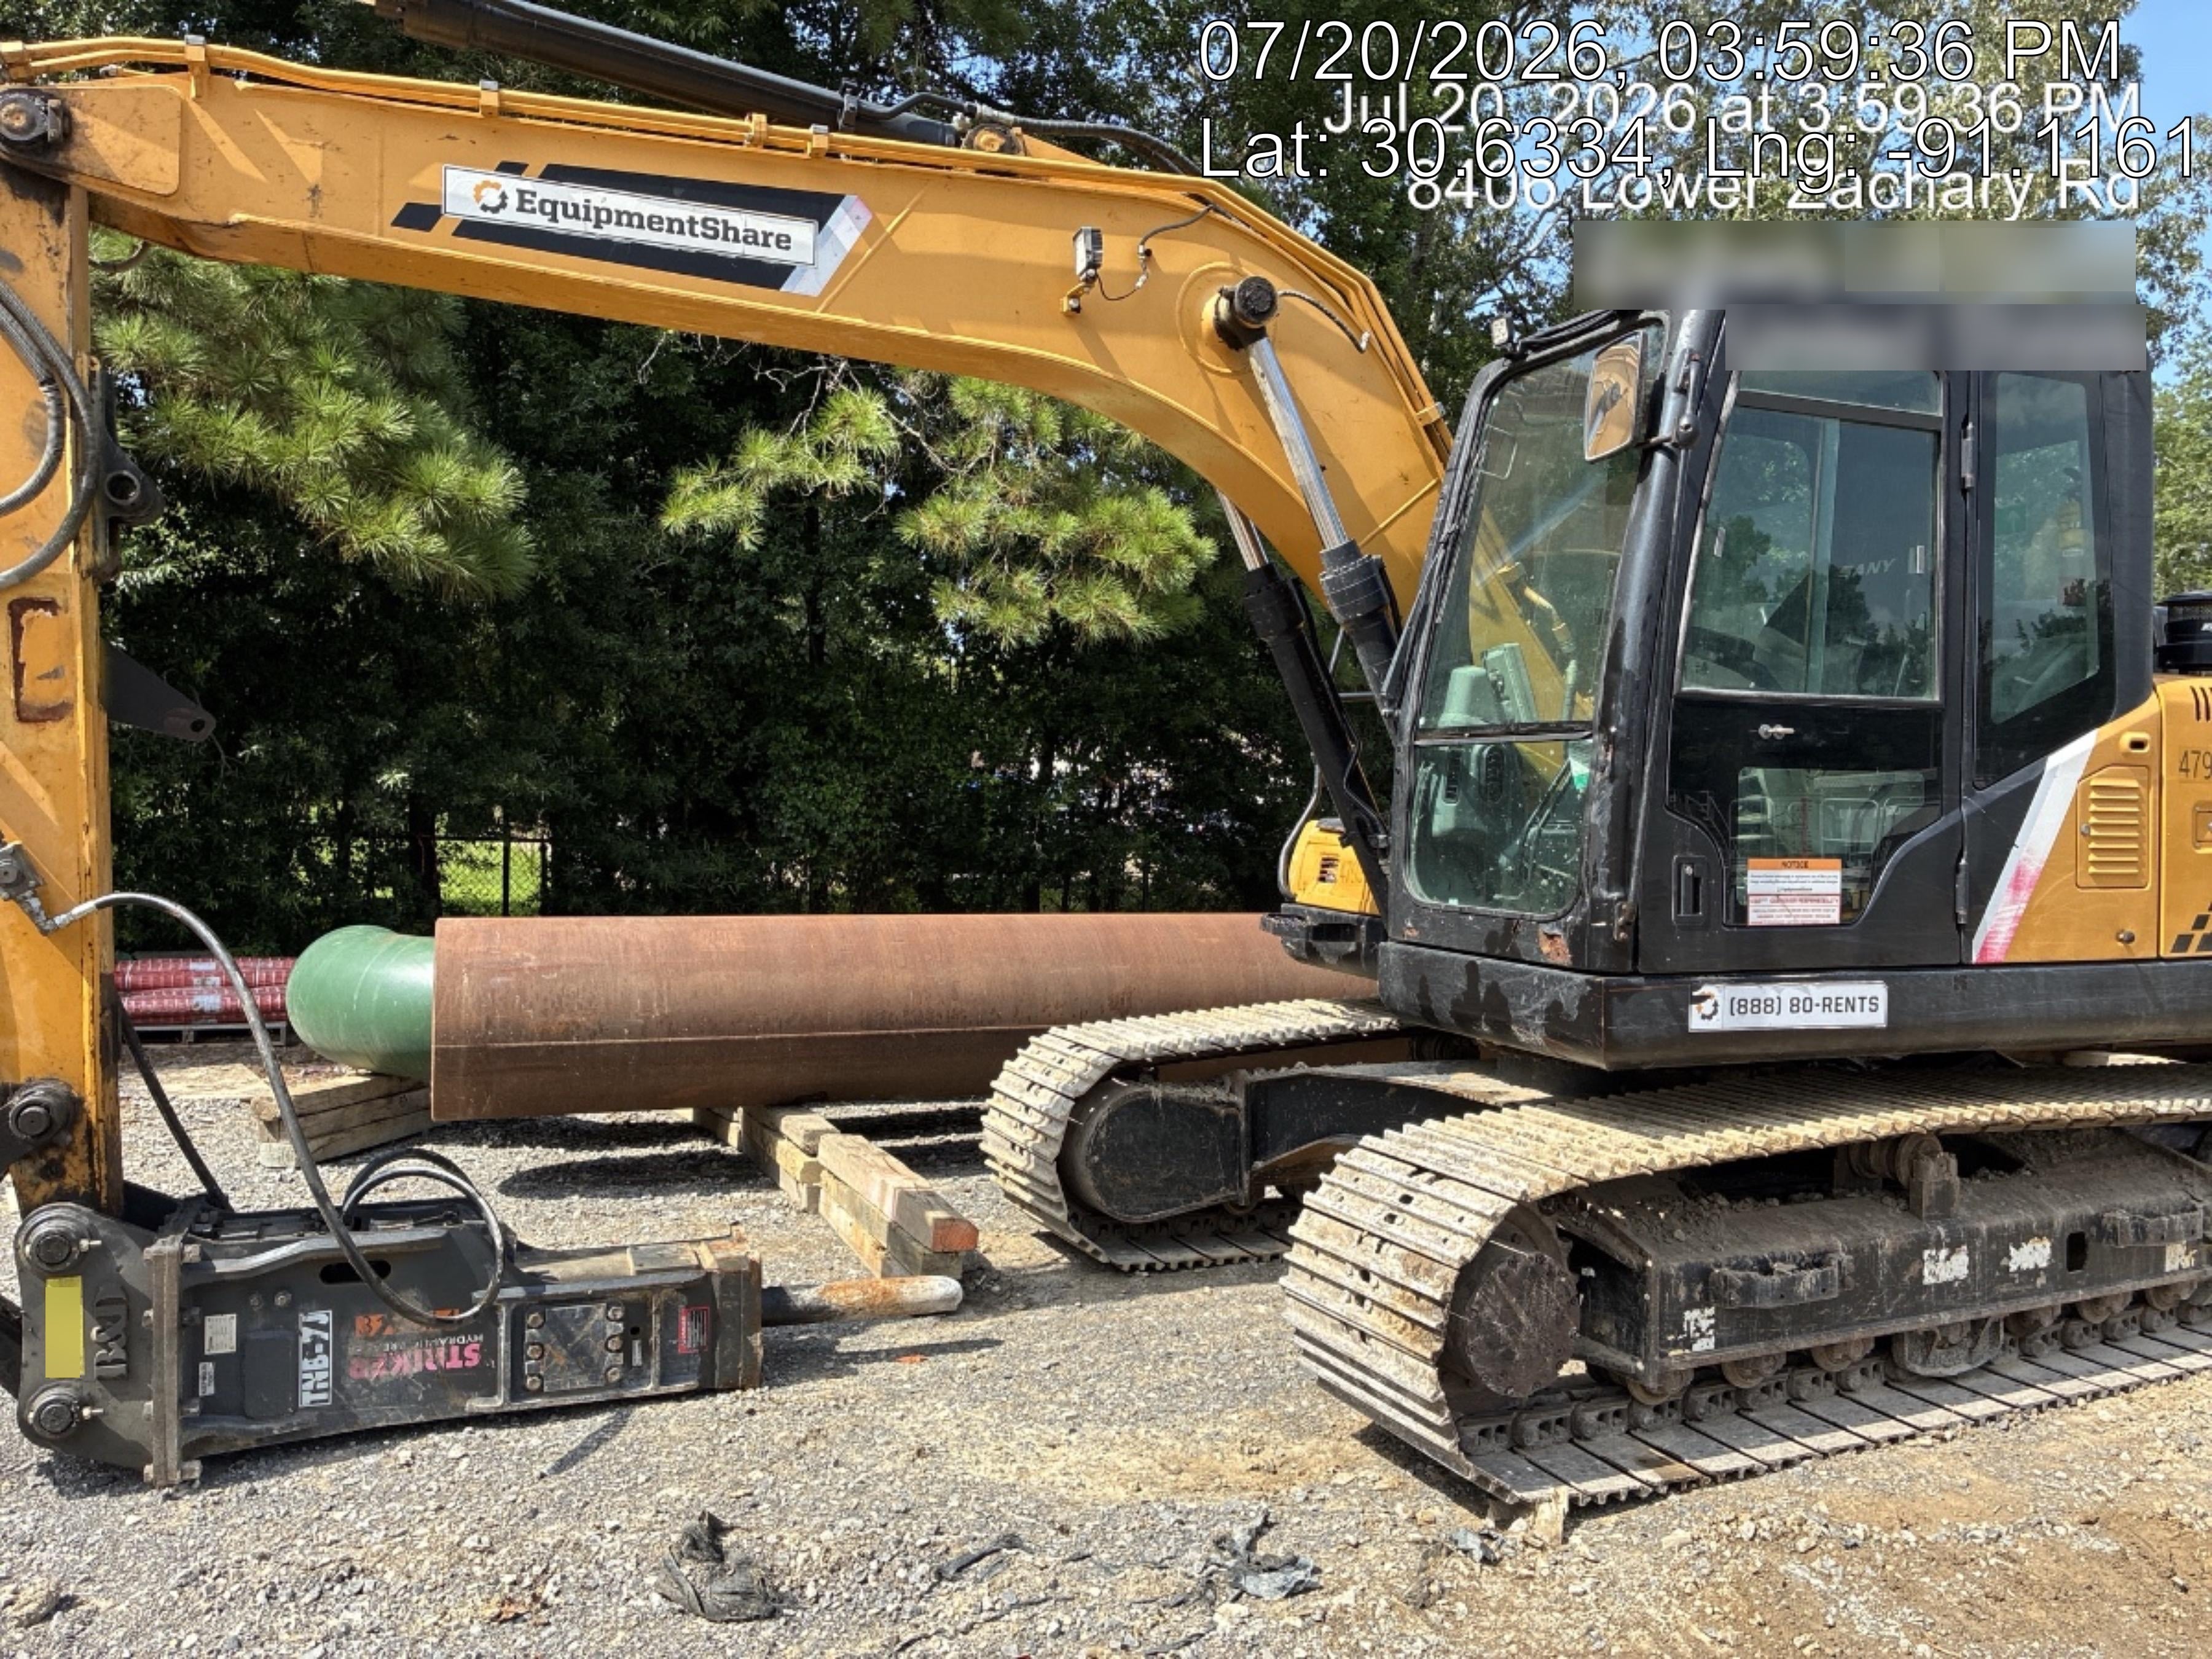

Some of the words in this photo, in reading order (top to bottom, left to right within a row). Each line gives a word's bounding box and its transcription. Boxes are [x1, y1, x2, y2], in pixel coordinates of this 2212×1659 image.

[515, 187, 793, 252] EquipmentShare
[1781, 860, 1810, 869] NOTICE
[1730, 996, 1781, 1016] (888)
[1789, 996, 1880, 1013] 80-RENTS
